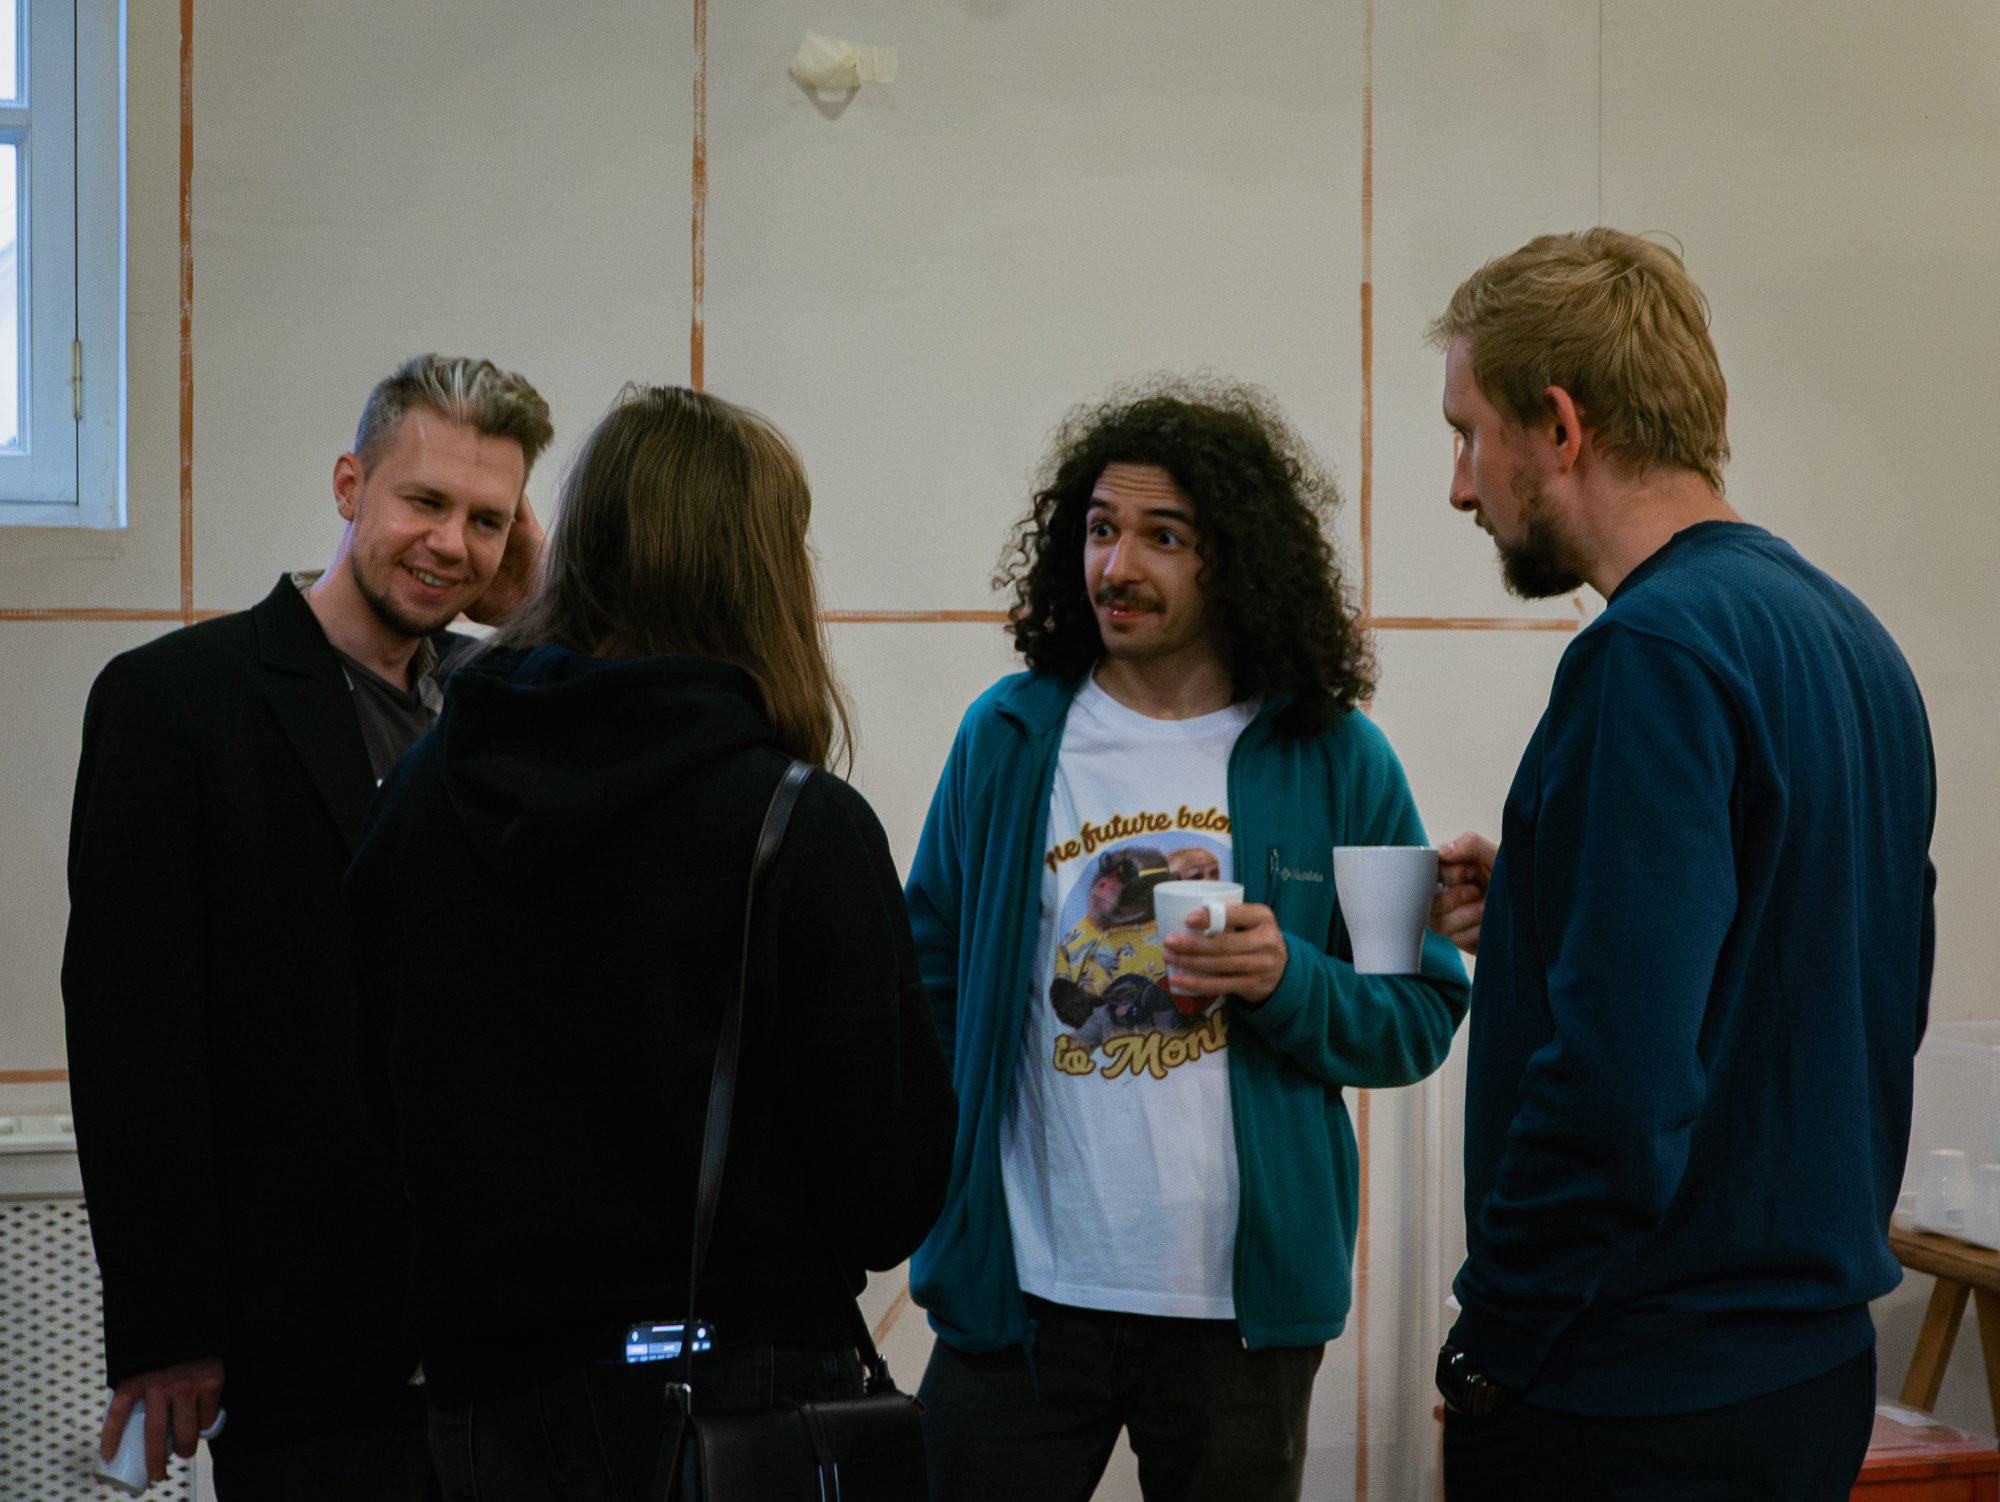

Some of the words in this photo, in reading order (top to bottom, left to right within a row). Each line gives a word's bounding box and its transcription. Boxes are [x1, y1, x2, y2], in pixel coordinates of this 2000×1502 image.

[1080, 811, 1172, 856] future
[1178, 805, 1232, 833] belo
[1053, 1034, 1096, 1076] to
